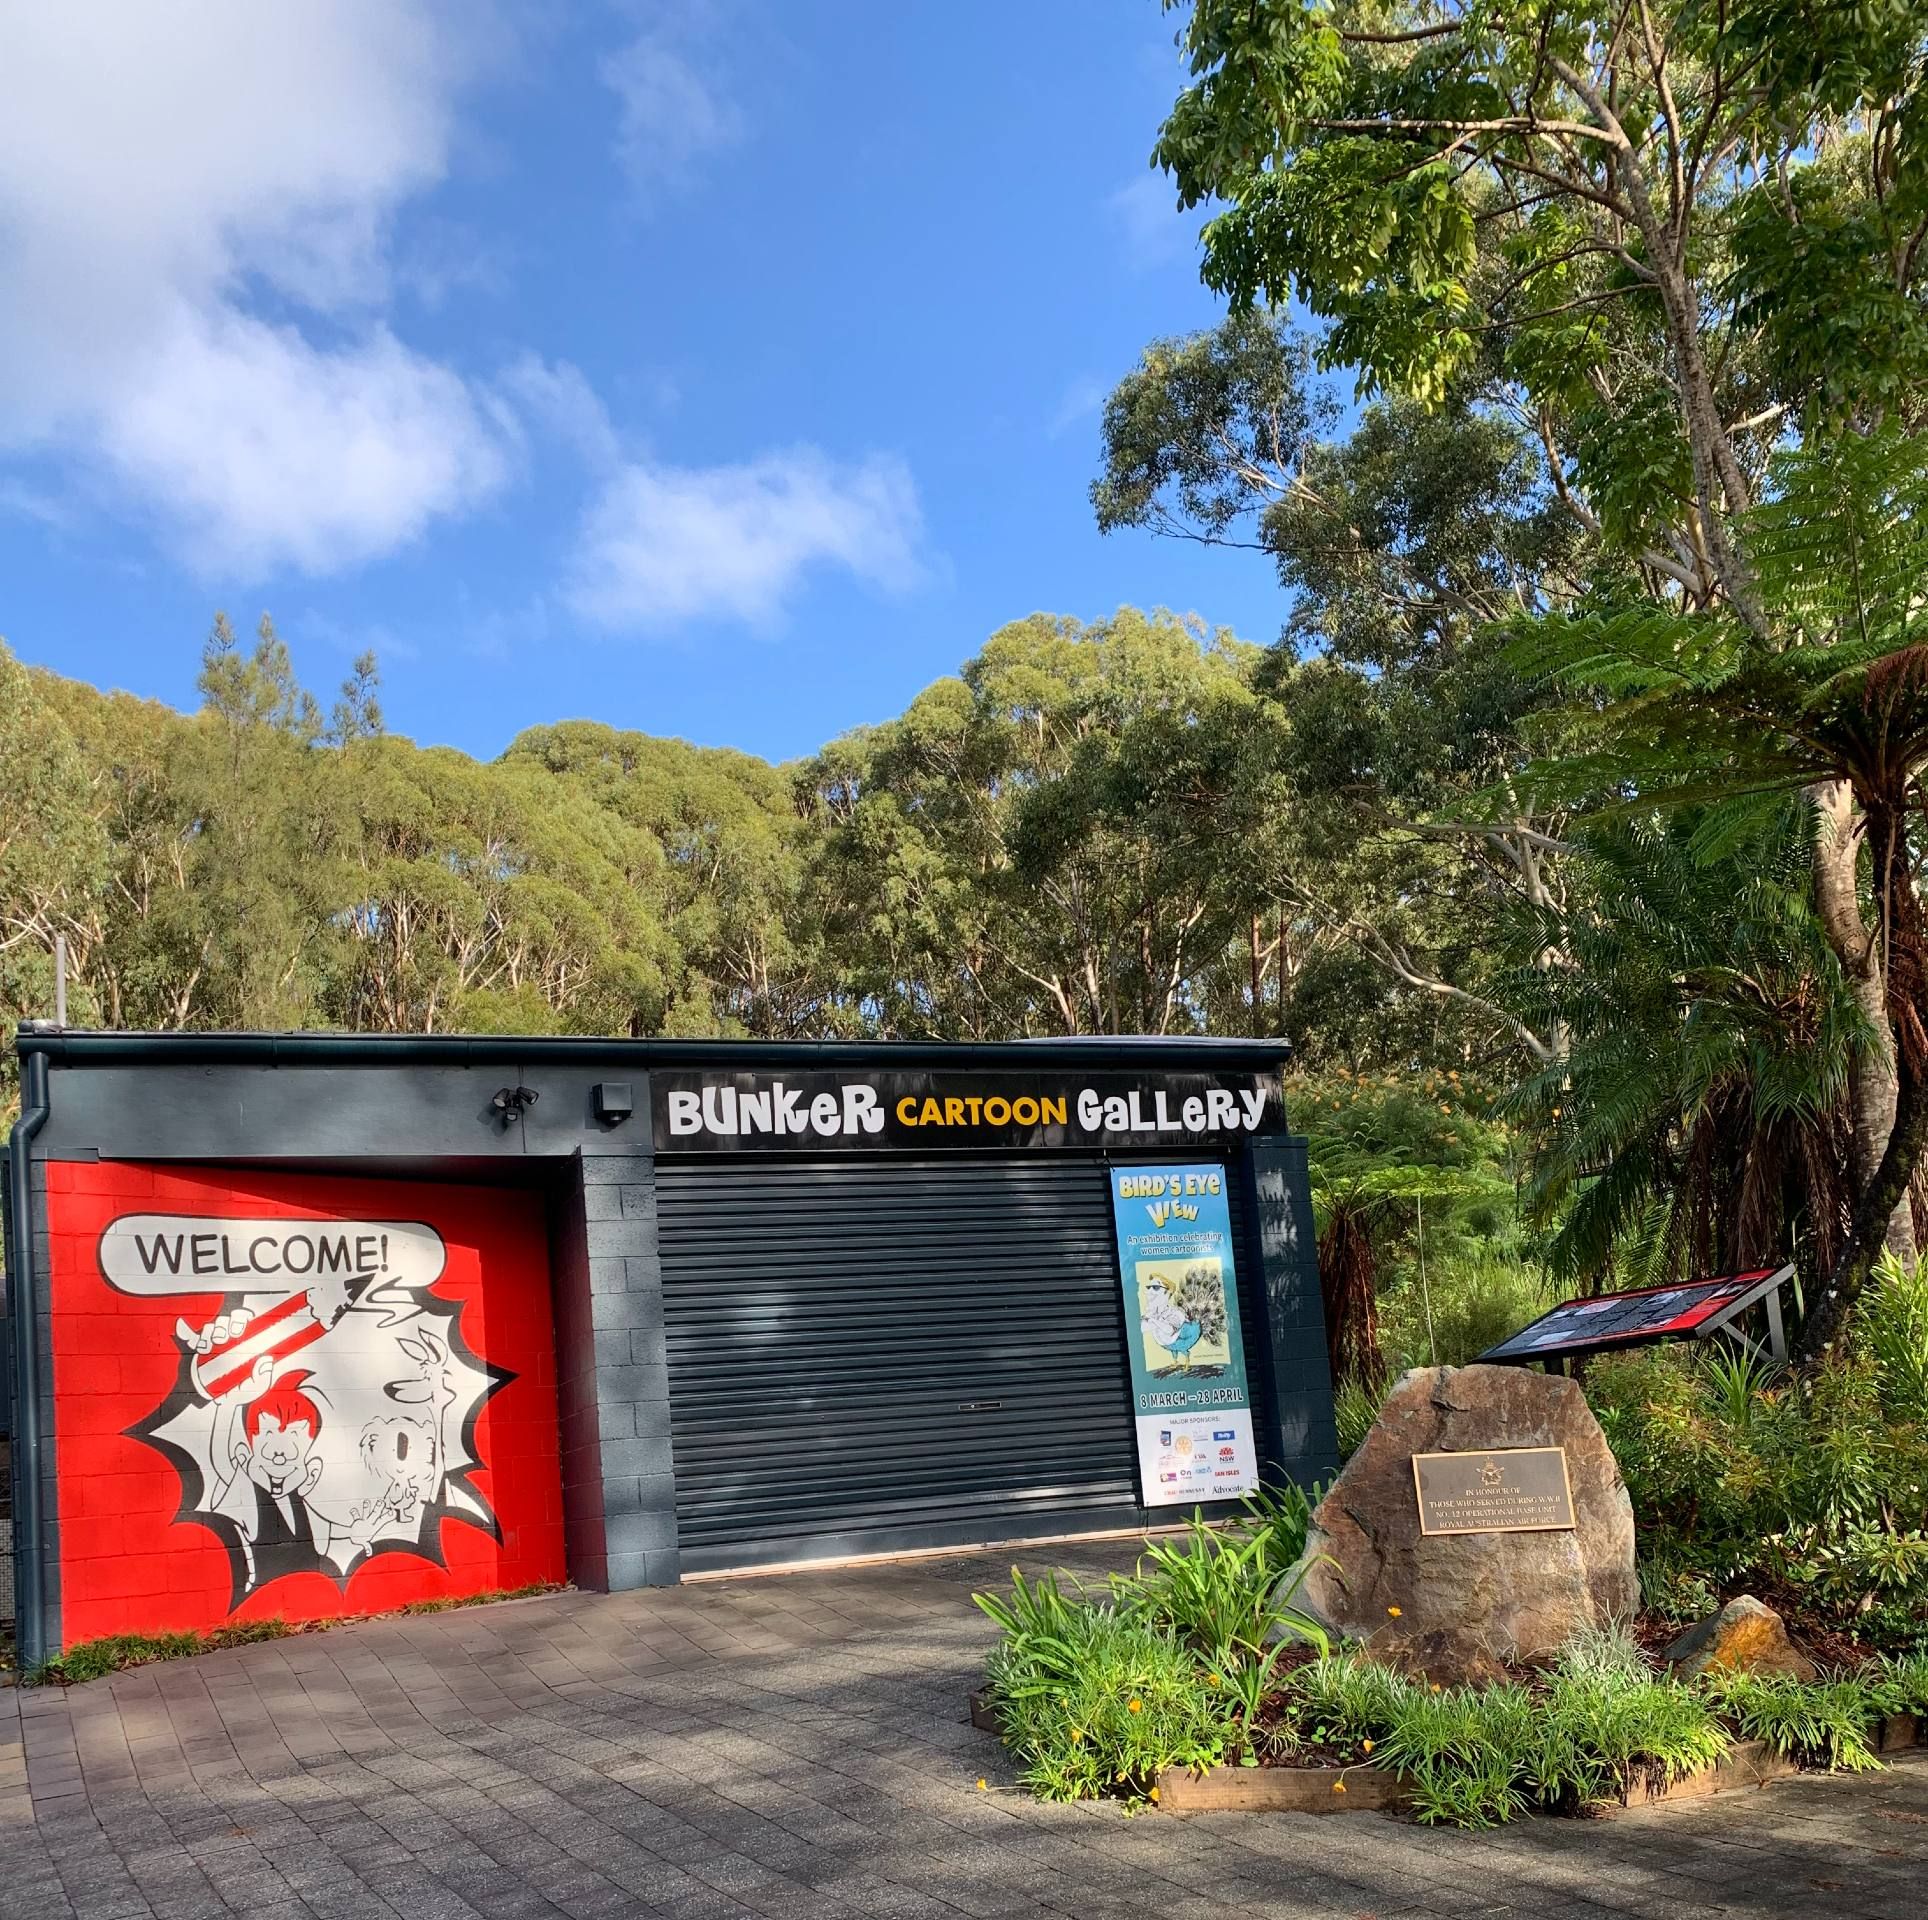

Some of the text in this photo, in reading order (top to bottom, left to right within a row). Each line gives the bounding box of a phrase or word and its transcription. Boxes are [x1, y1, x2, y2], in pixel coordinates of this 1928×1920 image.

[896, 1097, 1068, 1127] CARTOON
[1118, 1174, 1182, 1198] BIRD'S
[1127, 1231, 1222, 1244] An exhibition celebrating
[134, 1232, 390, 1275] WELCOME!
[1141, 1243, 1214, 1256] women cartoonists
[1141, 1394, 1147, 1408] 8
[1150, 1391, 1186, 1407] MARCH
[1213, 1387, 1243, 1403] APRIL
[1475, 1487, 1509, 1496] HONOUR
[1429, 1500, 1455, 1508] THOSE
[1456, 1499, 1475, 1507] WHO
[1476, 1497, 1507, 1506] SERVED
[1507, 1496, 1537, 1505] DURING
[1462, 1508, 1515, 1517] OPERATIONAL
[1517, 1506, 1536, 1514] BASE
[1538, 1505, 1556, 1513] UNIT
[1439, 1520, 1465, 1529] ROYAL
[1466, 1518, 1515, 1528] AUSTRALIAN
[1517, 1517, 1530, 1525] AIR
